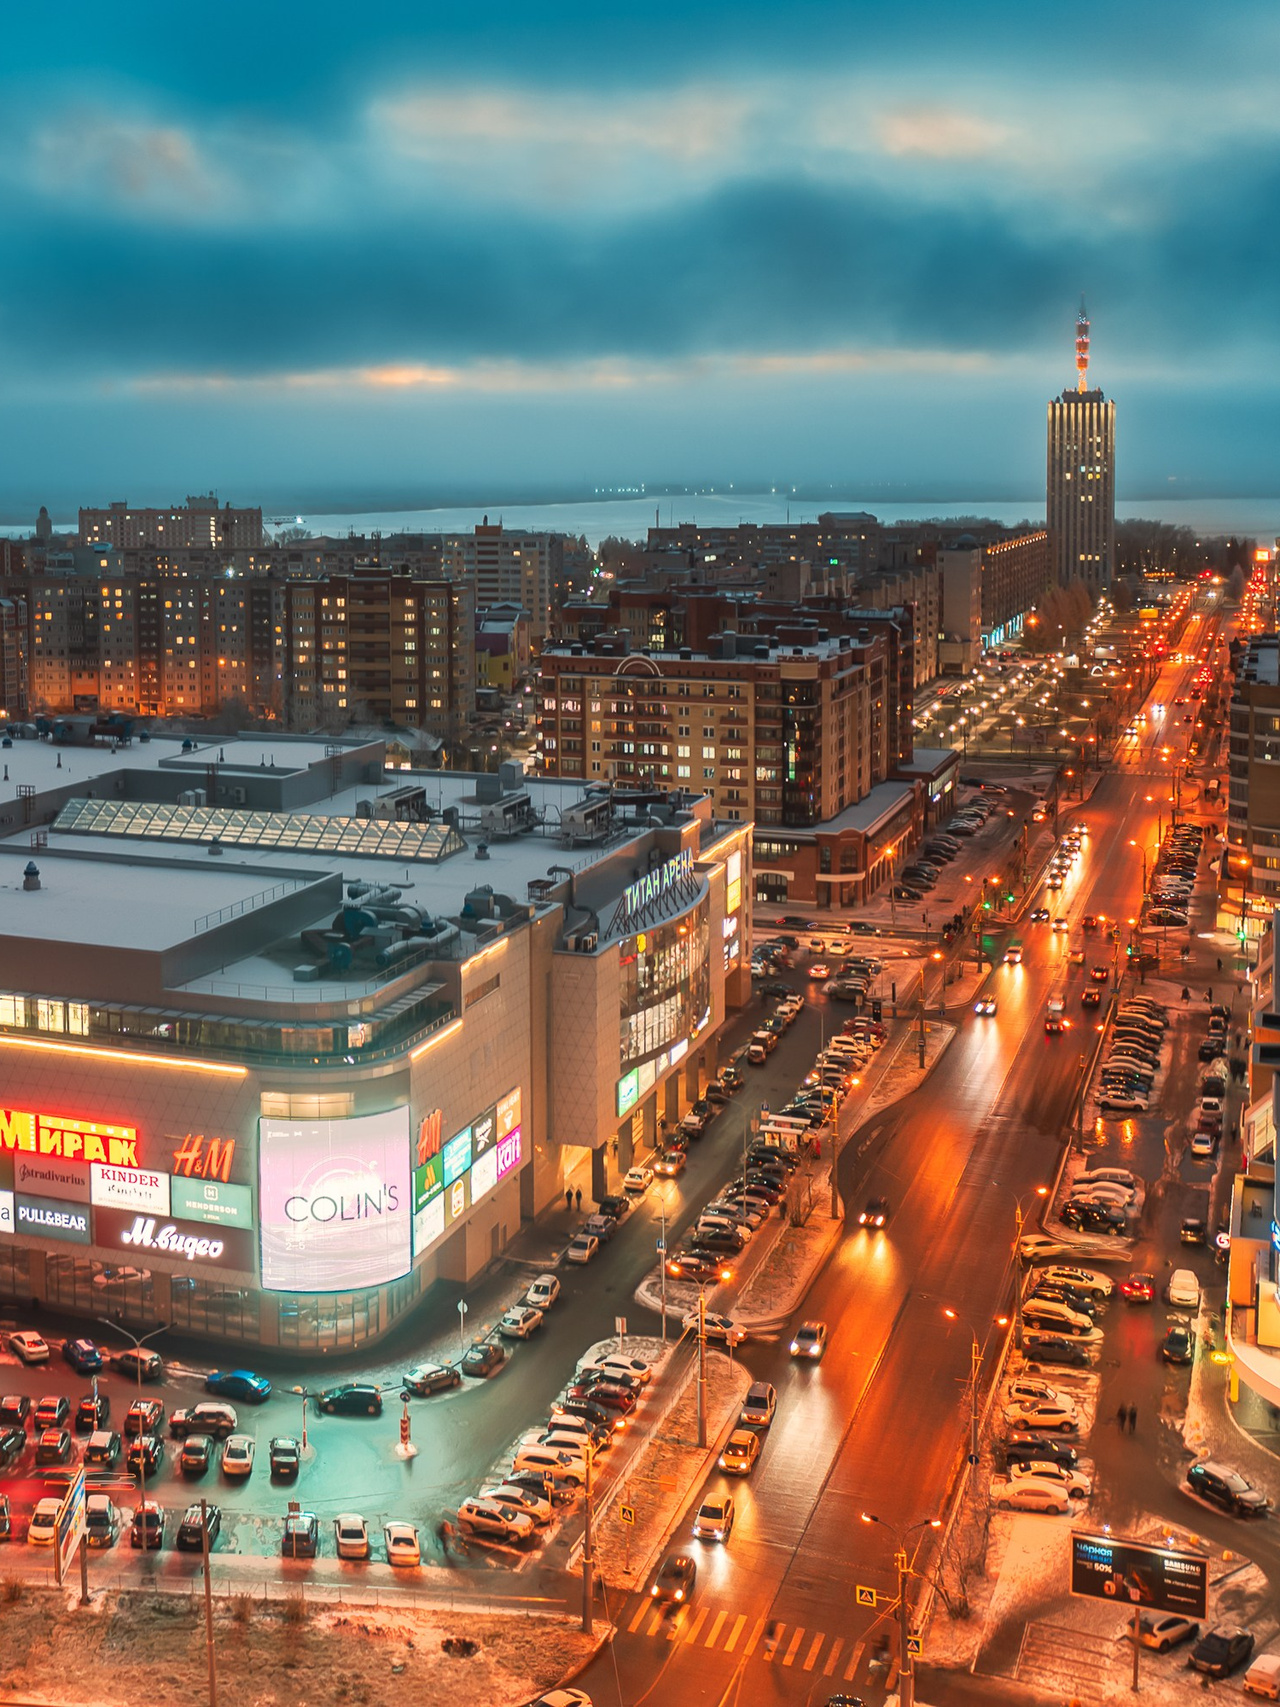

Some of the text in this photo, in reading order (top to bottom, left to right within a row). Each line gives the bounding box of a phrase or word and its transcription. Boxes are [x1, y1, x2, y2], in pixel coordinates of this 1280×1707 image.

[624, 847, 694, 915] ТИТАН АРЕНА
[173, 1133, 235, 1183] H&M
[101, 1168, 160, 1187] KINDER
[185, 1200, 238, 1215] HENDERSON
[284, 1183, 399, 1222] COLIN'S
[19, 1206, 87, 1231] PULL&BEAR
[1164, 1559, 1201, 1573] SAMSUNG
